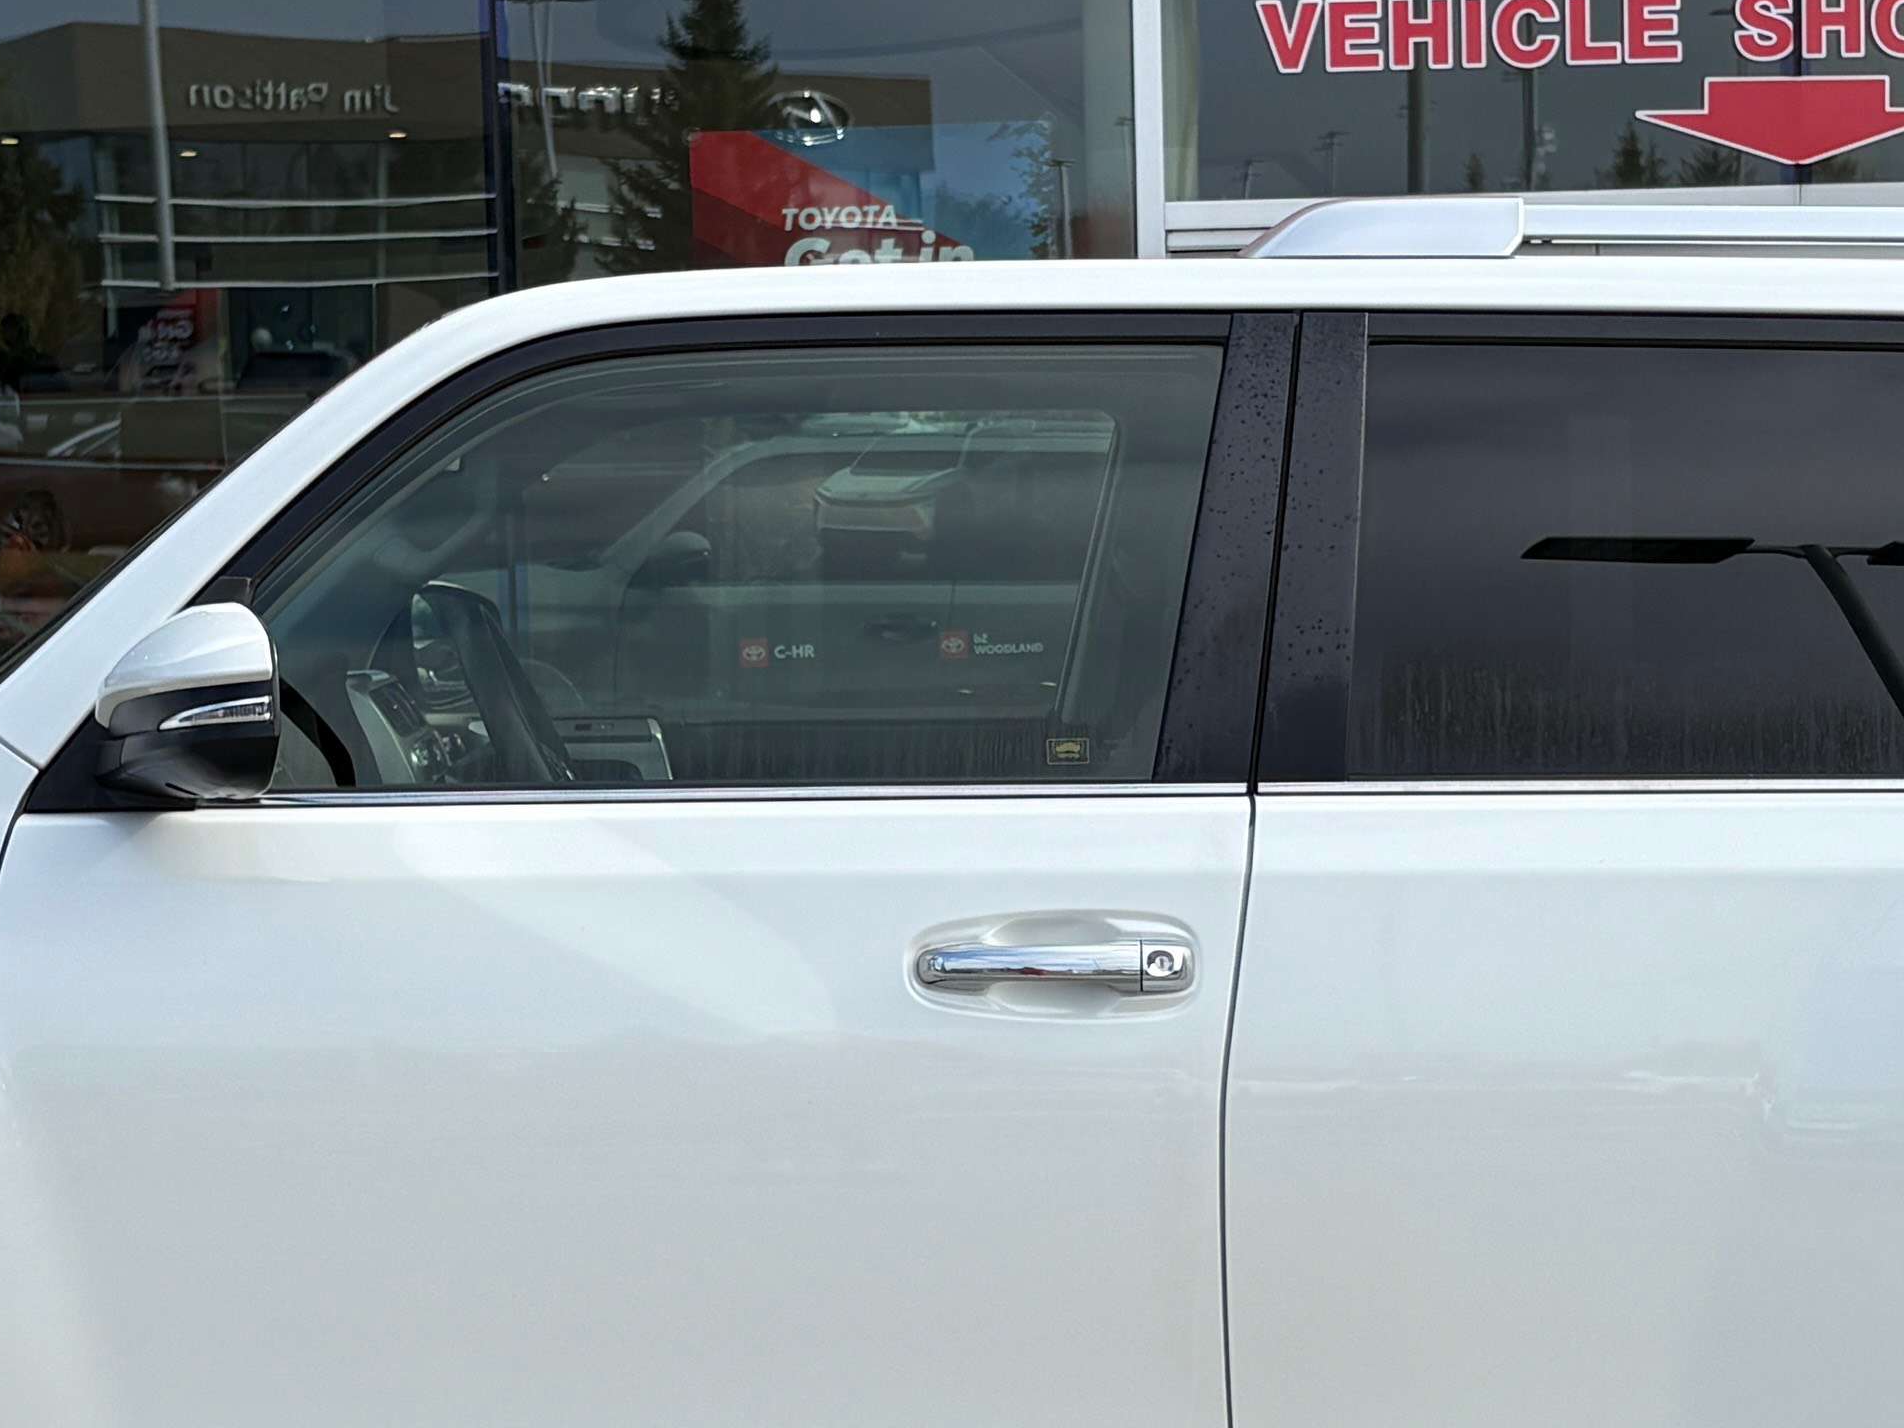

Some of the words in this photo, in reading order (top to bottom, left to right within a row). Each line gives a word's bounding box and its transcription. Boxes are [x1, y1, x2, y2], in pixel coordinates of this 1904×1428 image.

[782, 204, 897, 232] TOYOTA
[773, 644, 816, 660] C-HR
[973, 642, 1044, 655] WOODLAND
